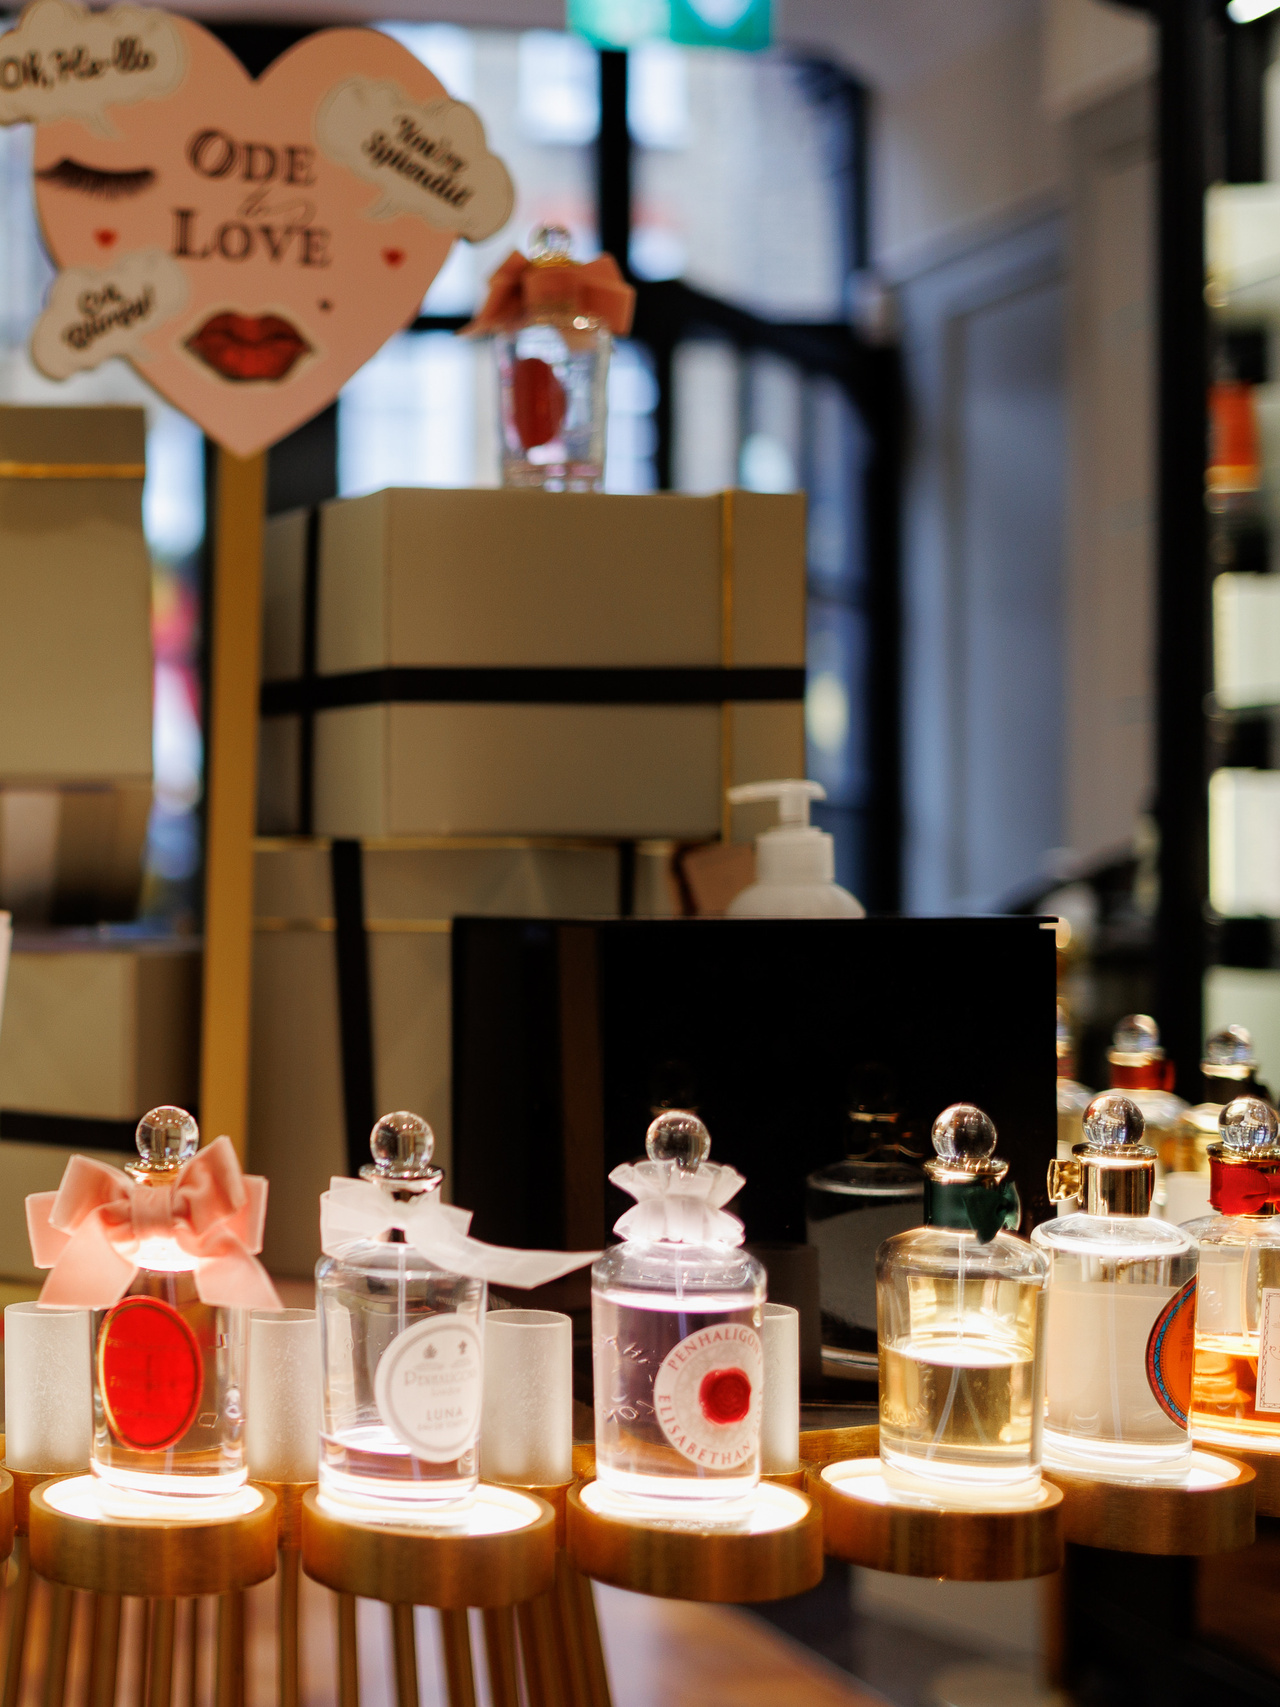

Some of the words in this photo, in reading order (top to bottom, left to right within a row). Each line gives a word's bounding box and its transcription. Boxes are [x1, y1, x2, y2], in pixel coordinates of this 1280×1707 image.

[185, 129, 318, 187] ODE
[170, 208, 332, 268] LOVE
[668, 1327, 761, 1371] PENHALIGON
[426, 1406, 463, 1421] LUNA
[658, 1394, 751, 1465] ELISABETHAN
